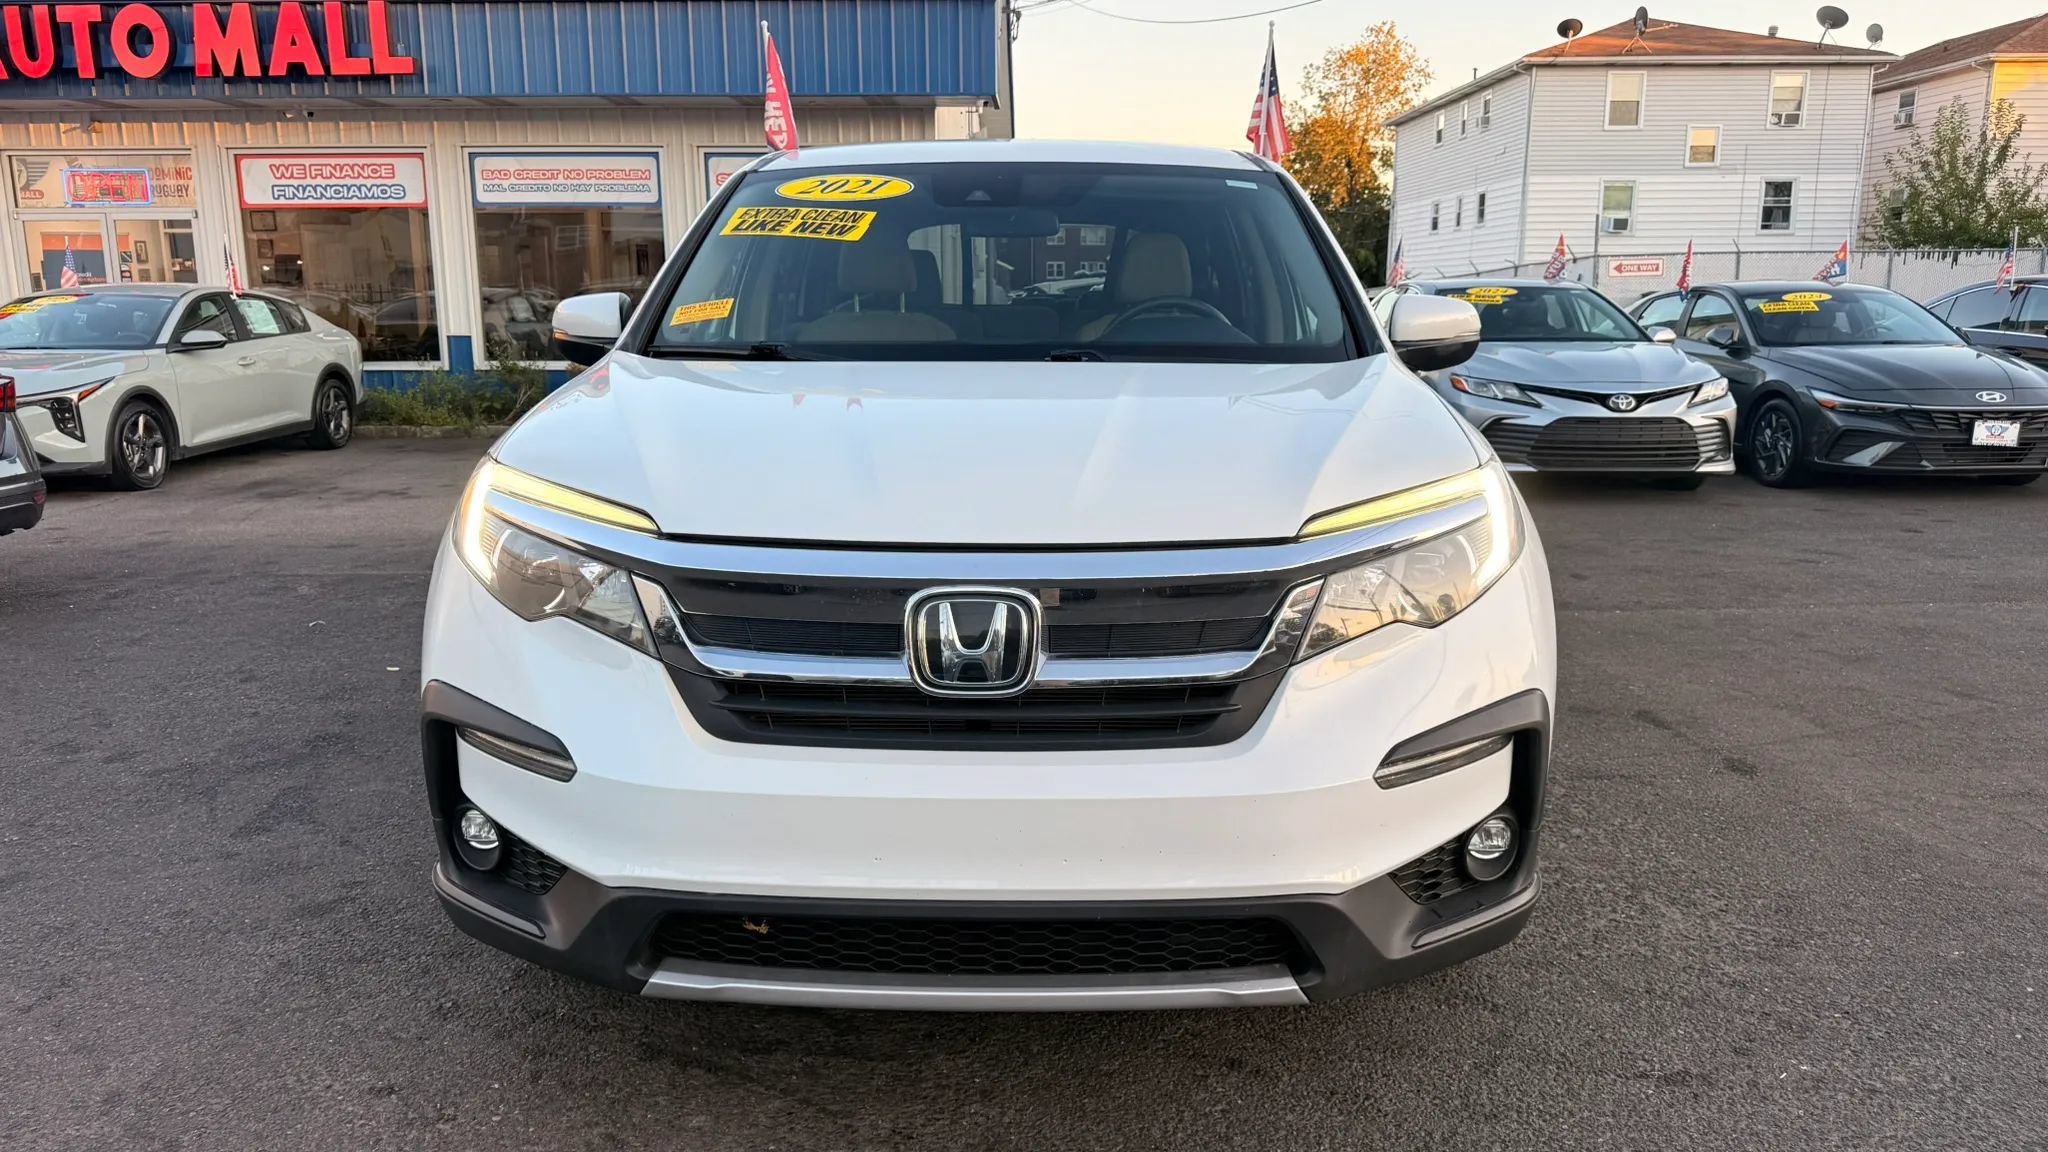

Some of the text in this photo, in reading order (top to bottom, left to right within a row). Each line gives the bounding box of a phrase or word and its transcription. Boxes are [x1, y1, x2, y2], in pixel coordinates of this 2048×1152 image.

[0, 0, 415, 80] UTO MALL
[269, 163, 395, 180] WE FINANCE
[481, 168, 651, 181] BAD CREDIT NO PROBLEM
[67, 172, 149, 202] OPEN
[272, 184, 406, 200] FINANCIAMOS
[483, 183, 651, 193] MAL CREDITO NO HAY PROBLEMA
[796, 179, 892, 195] 2021
[738, 208, 866, 224] EXTRA CLEAN
[730, 219, 859, 237] LIKE NEW
[1621, 263, 1658, 272] ONE WAY
